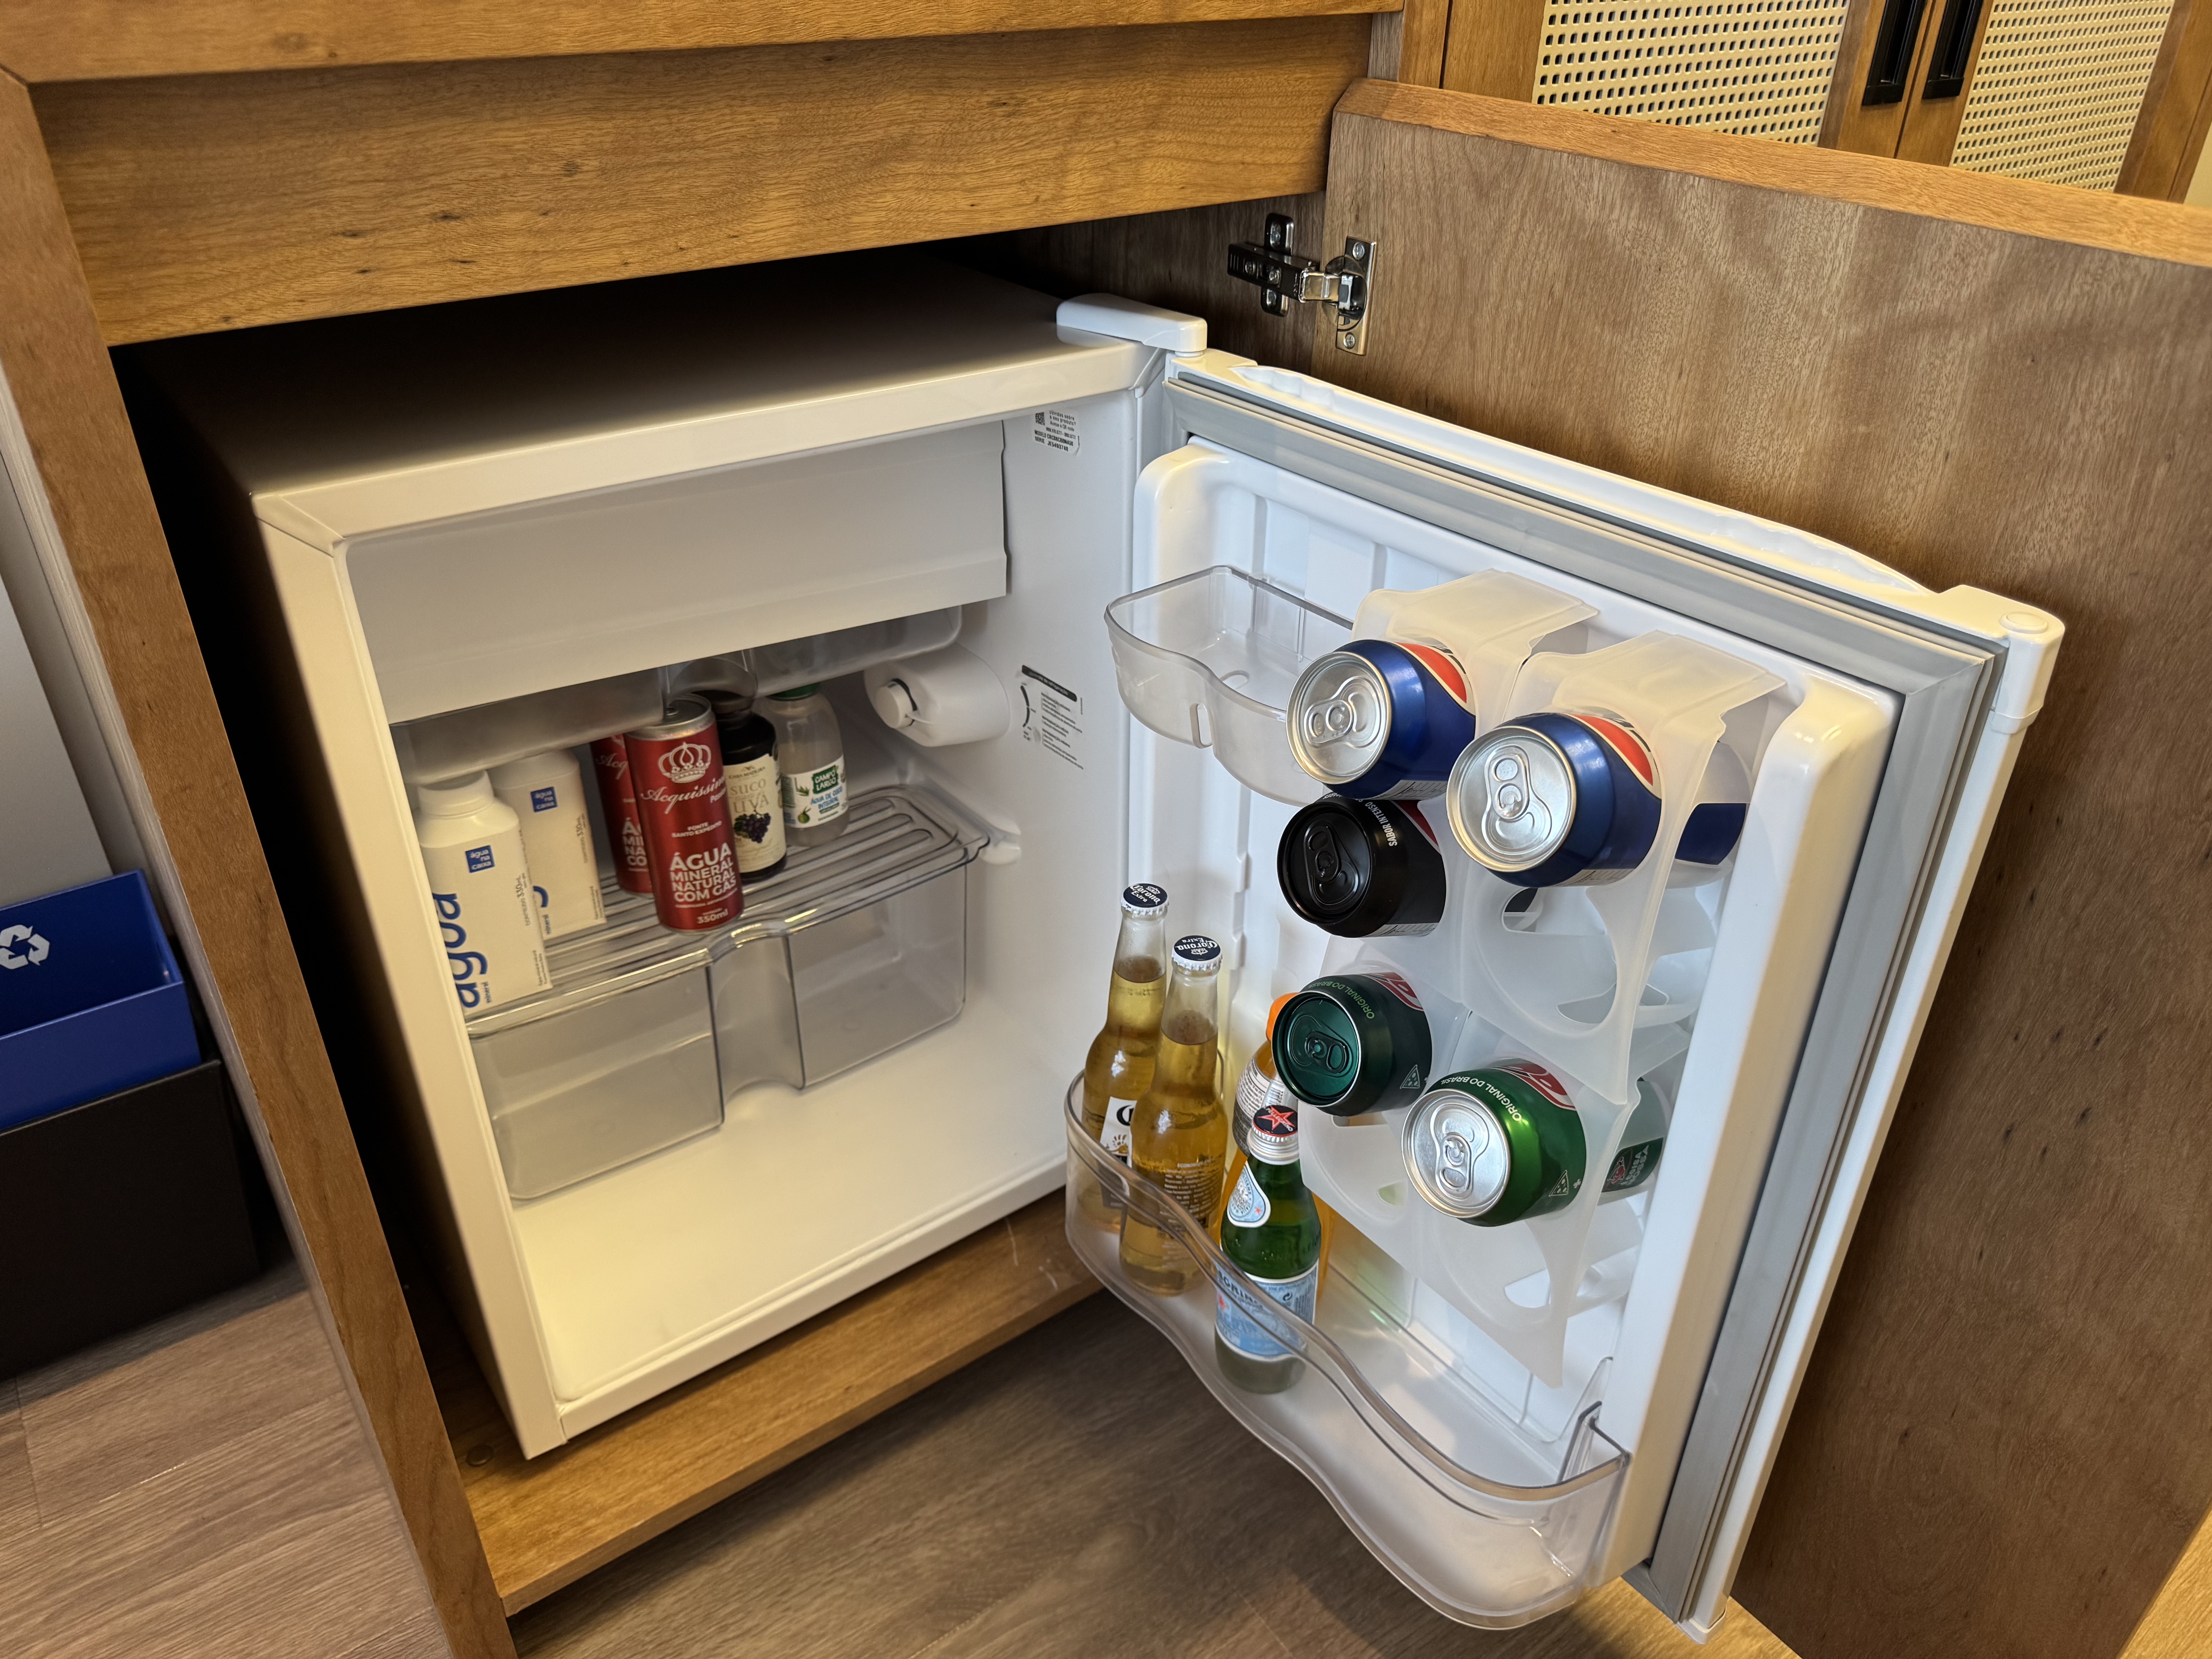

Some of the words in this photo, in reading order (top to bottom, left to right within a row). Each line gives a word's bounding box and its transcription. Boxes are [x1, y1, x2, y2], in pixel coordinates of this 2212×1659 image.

[730, 778, 766, 796] SUCO
[815, 770, 836, 783] CAMPO
[816, 777, 836, 791] LARGO
[536, 801, 555, 810] caixa
[733, 793, 769, 814] UVA
[1365, 802, 1389, 824] INTENSO
[1382, 823, 1398, 847] SABOR
[470, 848, 489, 860] água
[670, 842, 732, 871] ÁGUA
[471, 860, 492, 871] caixa
[670, 857, 733, 882] MINERAL
[672, 867, 735, 891] NATURAL
[674, 889, 710, 902] COM
[712, 876, 736, 896] GÁS
[1130, 884, 1161, 905] Corona
[1131, 890, 1147, 902] Extra
[1175, 940, 1218, 950] Corona
[482, 981, 493, 1004] mineral
[1345, 986, 1375, 1019] ORIGINAL
[1441, 1076, 1471, 1085] BRASIL
[1470, 1078, 1486, 1087] DO
[1485, 1083, 1522, 1121] ORIGINAL
